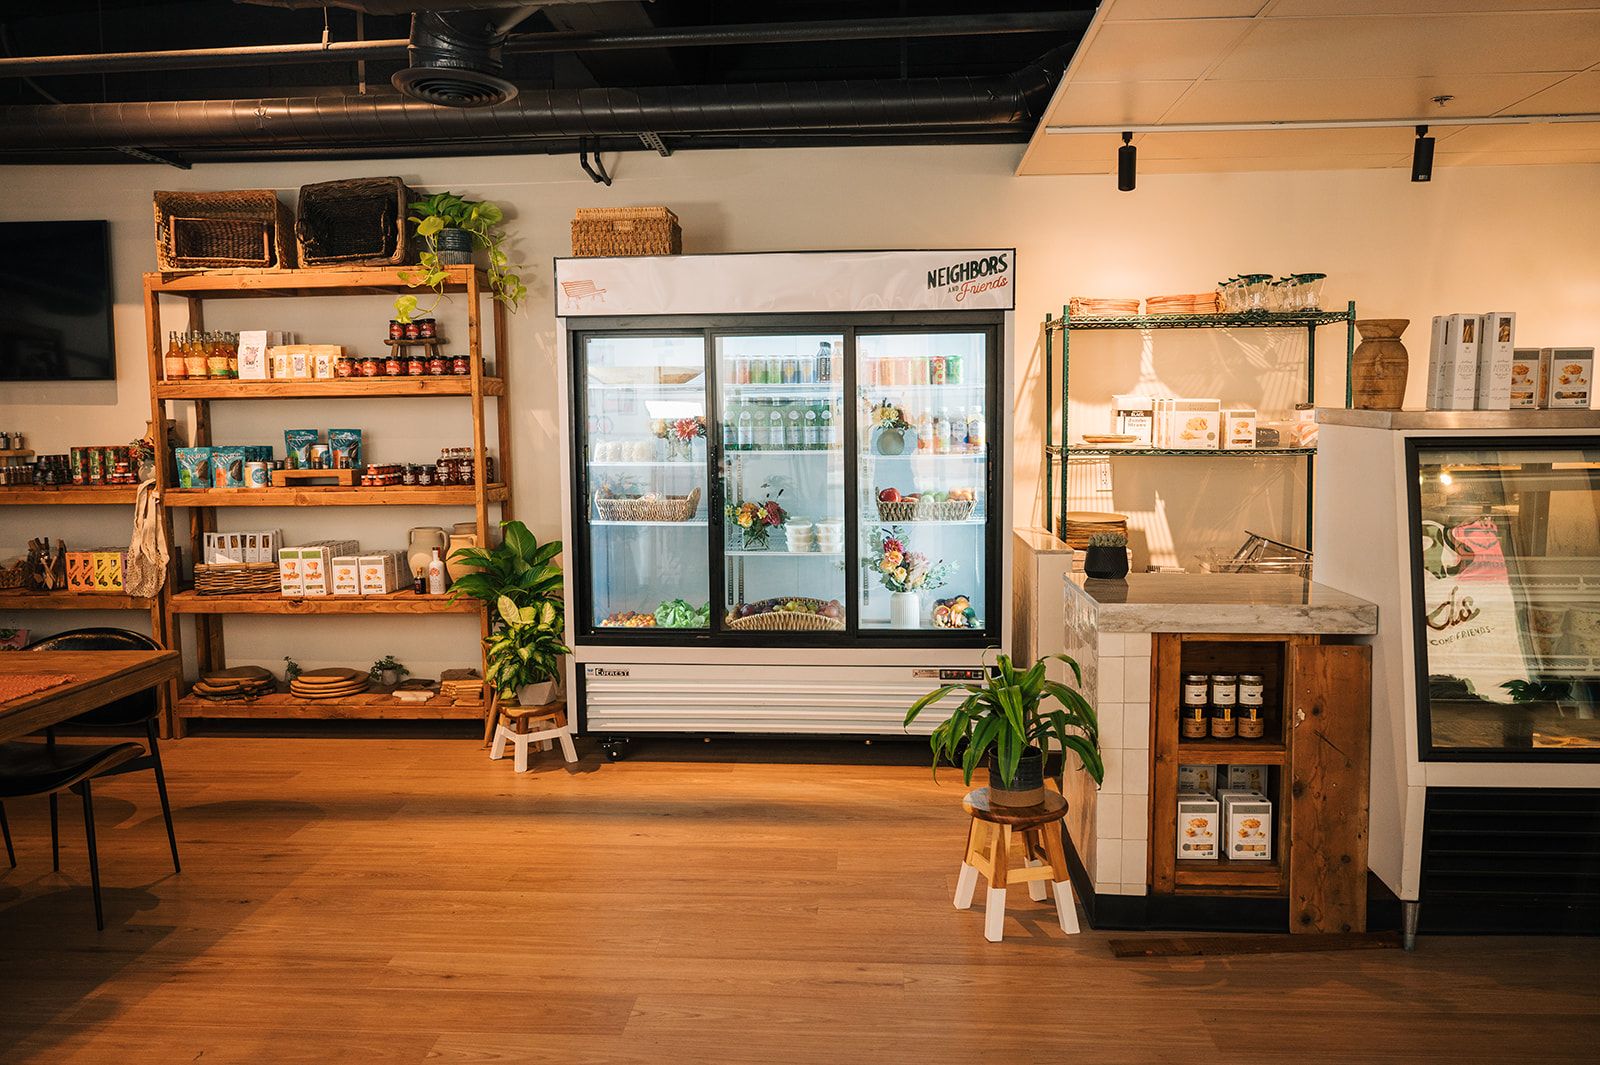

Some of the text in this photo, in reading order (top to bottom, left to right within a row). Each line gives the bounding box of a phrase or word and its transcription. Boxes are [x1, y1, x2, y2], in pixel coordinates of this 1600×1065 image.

[927, 253, 1008, 289] NEIGHBORS
[947, 275, 1008, 302] AND Friends
